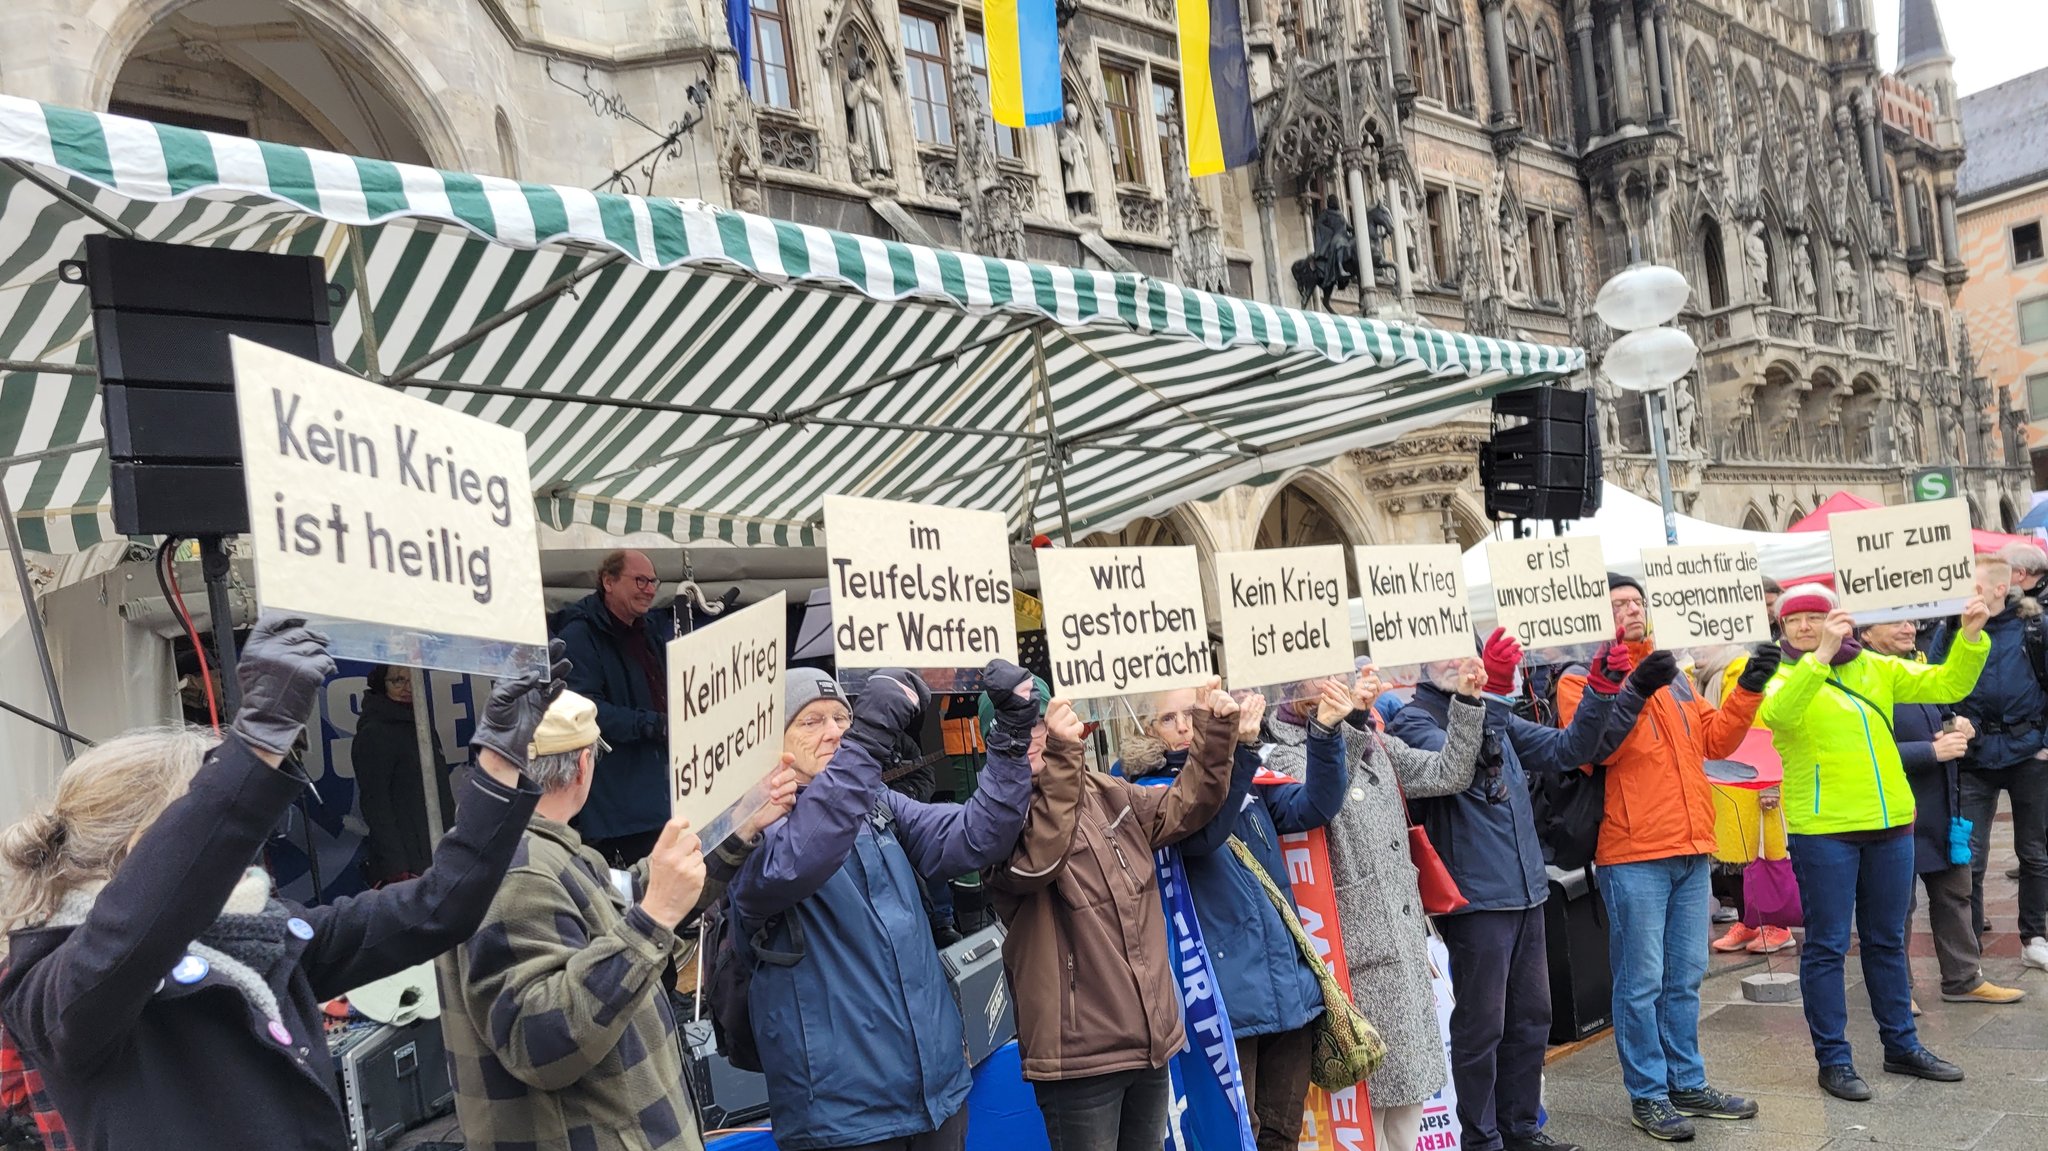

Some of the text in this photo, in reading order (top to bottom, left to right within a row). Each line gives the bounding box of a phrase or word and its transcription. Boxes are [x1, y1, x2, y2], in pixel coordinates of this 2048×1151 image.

[271, 387, 512, 527] Kein Krieg
[1921, 472, 1947, 500] S
[274, 491, 493, 605] ist heilig
[909, 519, 941, 551] im
[1856, 524, 1952, 553] nur zum
[1089, 555, 1146, 591] wird
[1526, 542, 1570, 571] er ist
[1644, 551, 1758, 578] und auch für die
[833, 558, 1011, 604] Teufelskreis
[1230, 566, 1340, 609] Kein Krieg
[1368, 562, 1457, 599] Kein Krieg
[1496, 574, 1607, 607] unvorstellbar
[1838, 556, 1972, 596] Verlieren gut
[1651, 580, 1763, 617] sogenannten
[837, 610, 1000, 654] der Waffen
[1062, 601, 1197, 651] gestorben
[1251, 617, 1331, 657] ist edel
[1368, 605, 1470, 642] lebt von Mut
[1518, 612, 1602, 647] grausam
[1687, 610, 1754, 642] Sieger
[682, 637, 777, 722] Kein Krieg
[1056, 640, 1209, 690] und gerächt
[674, 698, 775, 802] ist gerecht
[1420, 1113, 1451, 1132] stat
